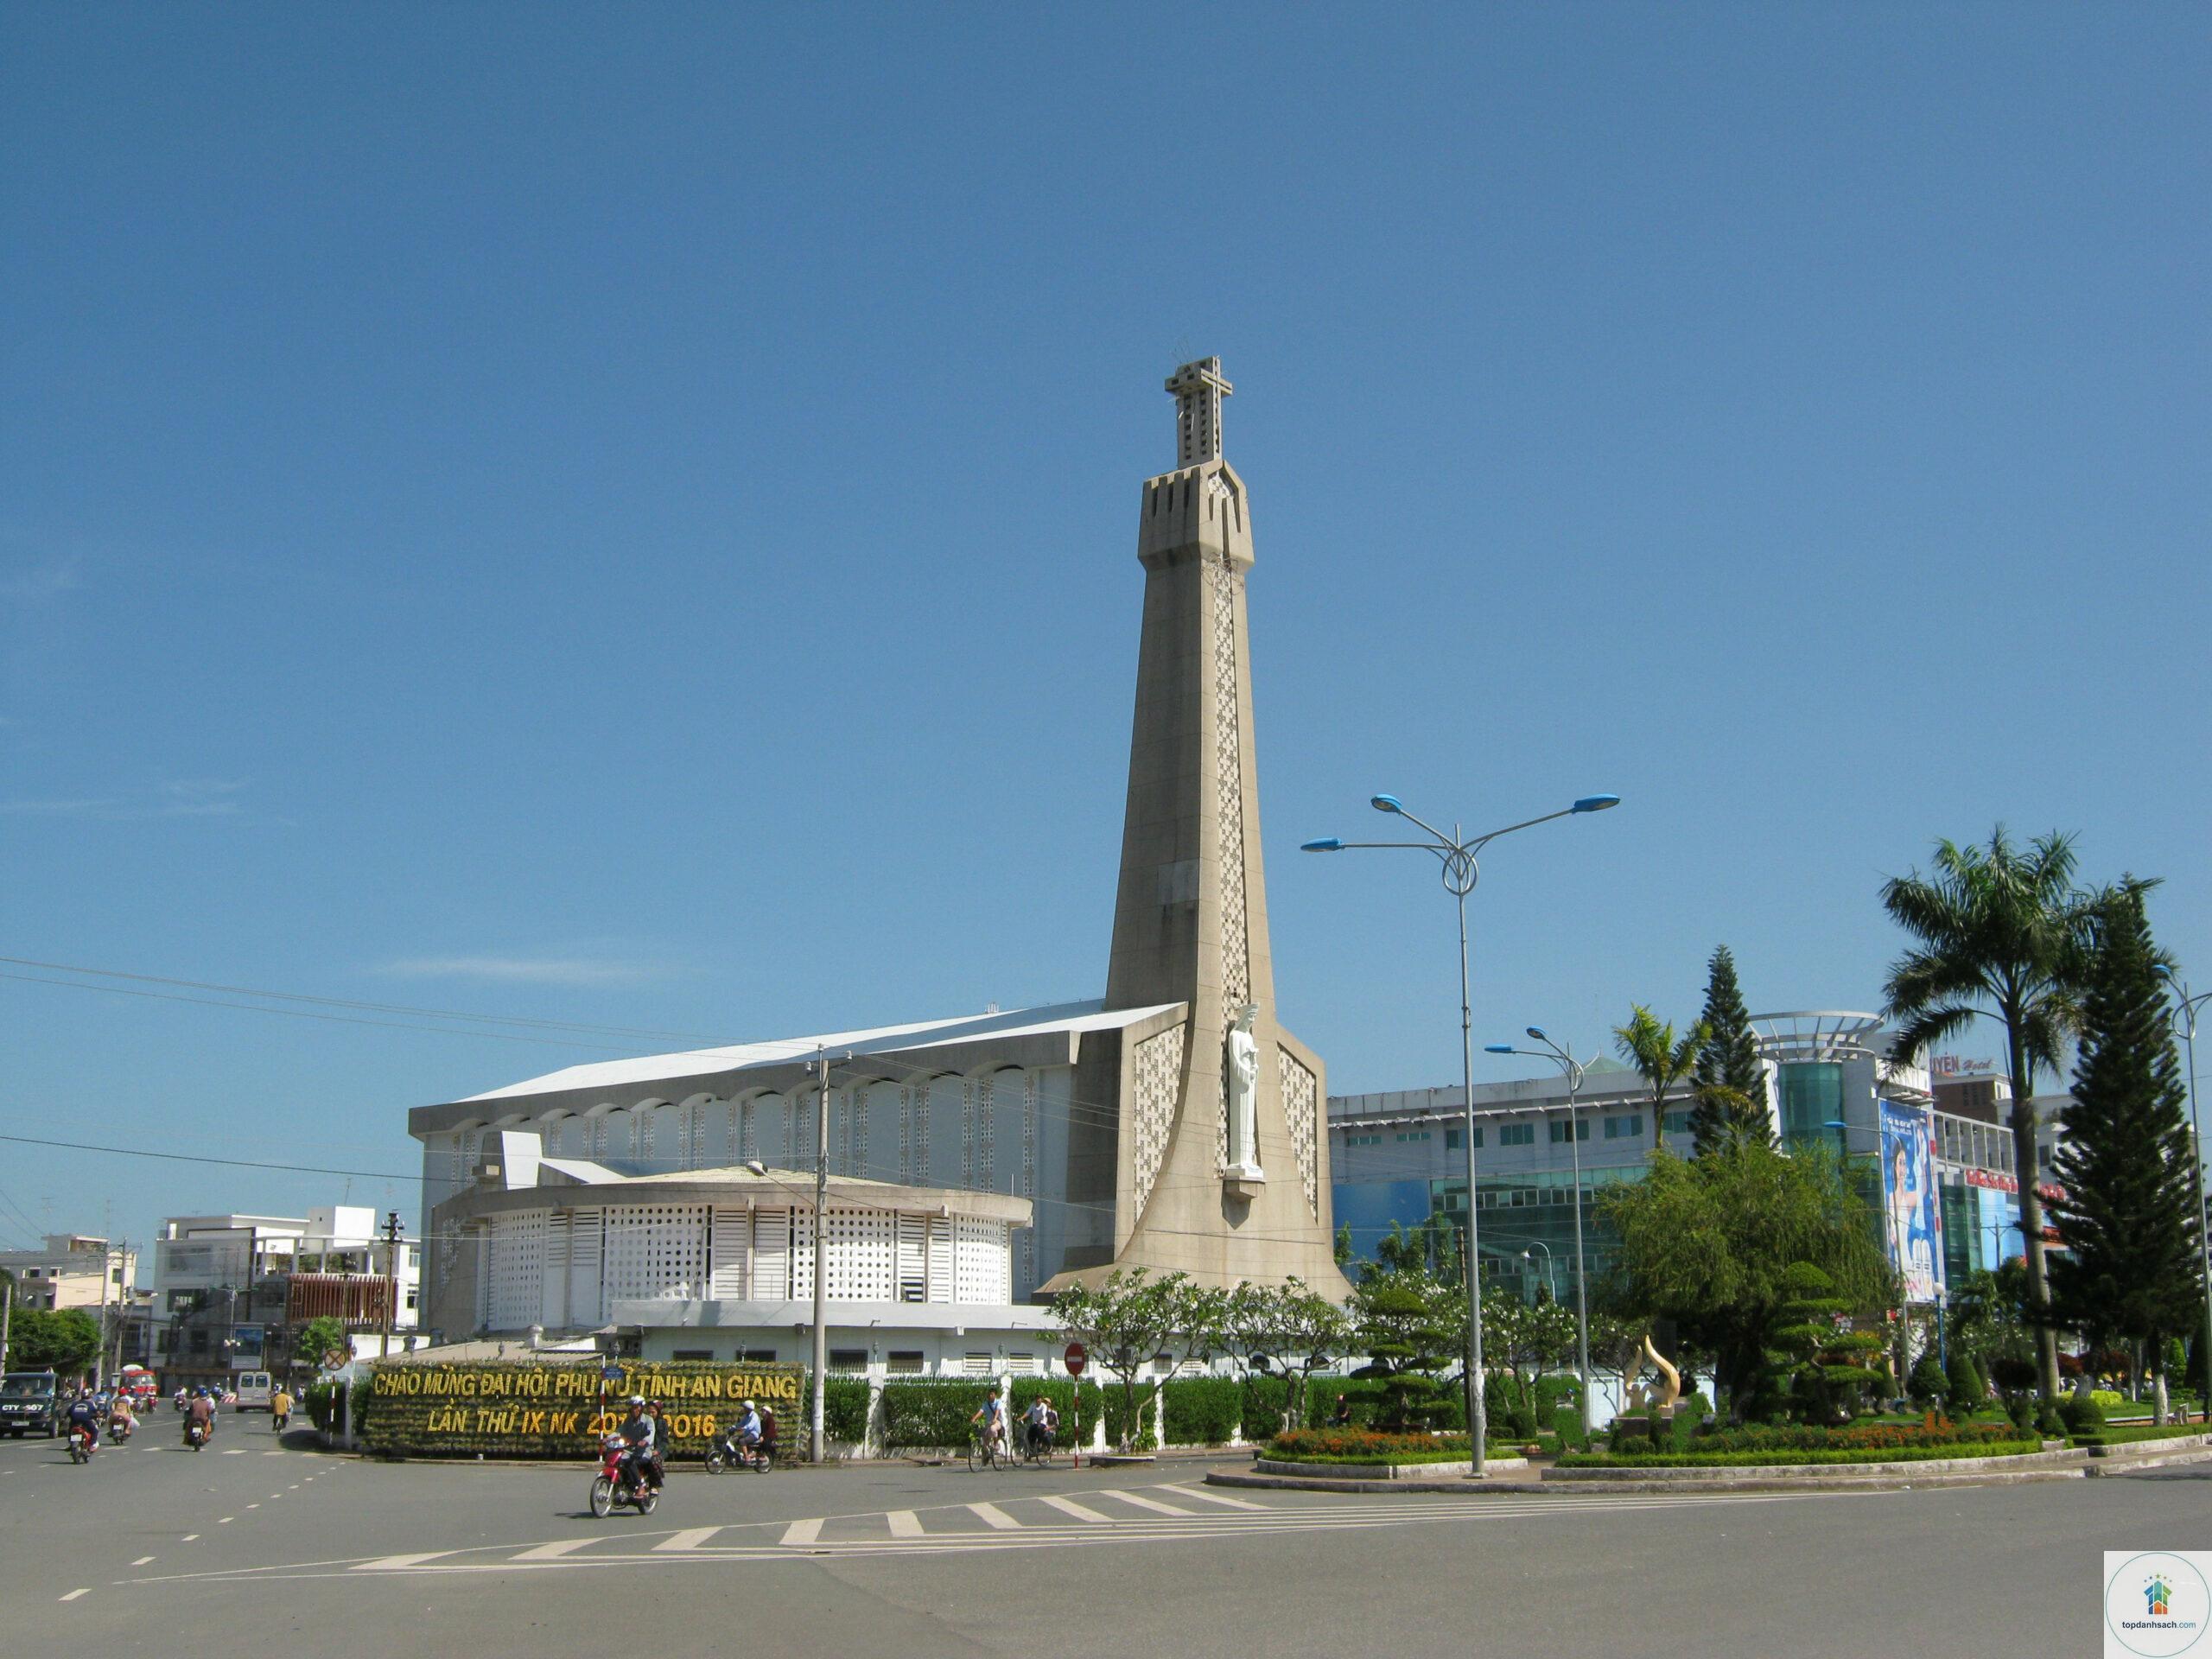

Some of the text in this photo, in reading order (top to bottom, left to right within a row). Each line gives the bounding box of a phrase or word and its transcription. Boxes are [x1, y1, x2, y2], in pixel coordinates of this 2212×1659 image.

[374, 1367, 421, 1395] CHÀO
[423, 1364, 475, 1396] MỪNG
[480, 1373, 512, 1400] ĐẠI
[514, 1367, 550, 1403] HỘI
[555, 1373, 597, 1403] PHỤ
[636, 1363, 687, 1397] TỈNH
[690, 1374, 721, 1398] AN
[727, 1375, 797, 1399] GIANG
[428, 1398, 467, 1432] LẦN
[476, 1402, 520, 1433] THỨ
[521, 1411, 545, 1433] IX
[550, 1412, 579, 1434] NK
